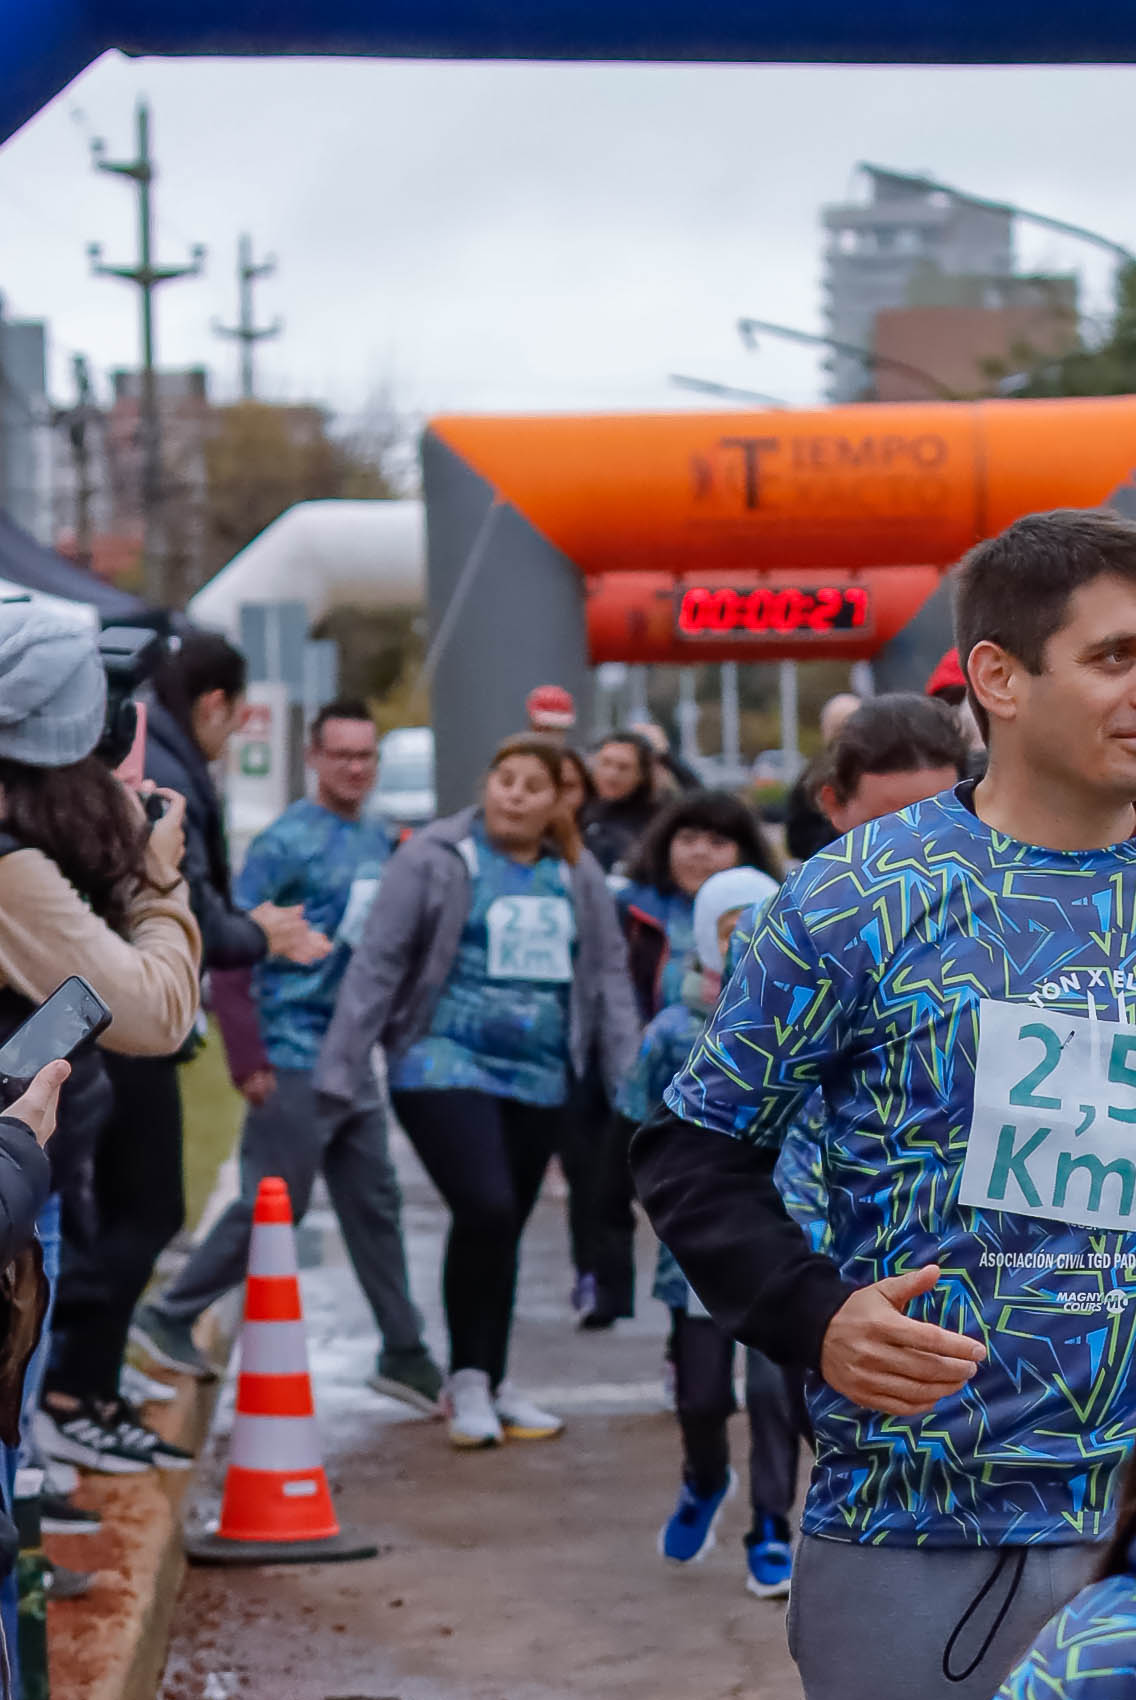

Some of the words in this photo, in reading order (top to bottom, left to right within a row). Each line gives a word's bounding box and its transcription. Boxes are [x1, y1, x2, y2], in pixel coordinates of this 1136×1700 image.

[1087, 969, 1106, 988] X
[978, 1248, 1053, 1269] ASOCIACIÓN
[1056, 1254, 1085, 1269] CIVIL
[1087, 1253, 1111, 1269] TGD
[1056, 1292, 1103, 1302] MAGNY
[1063, 1302, 1103, 1312] COURS
